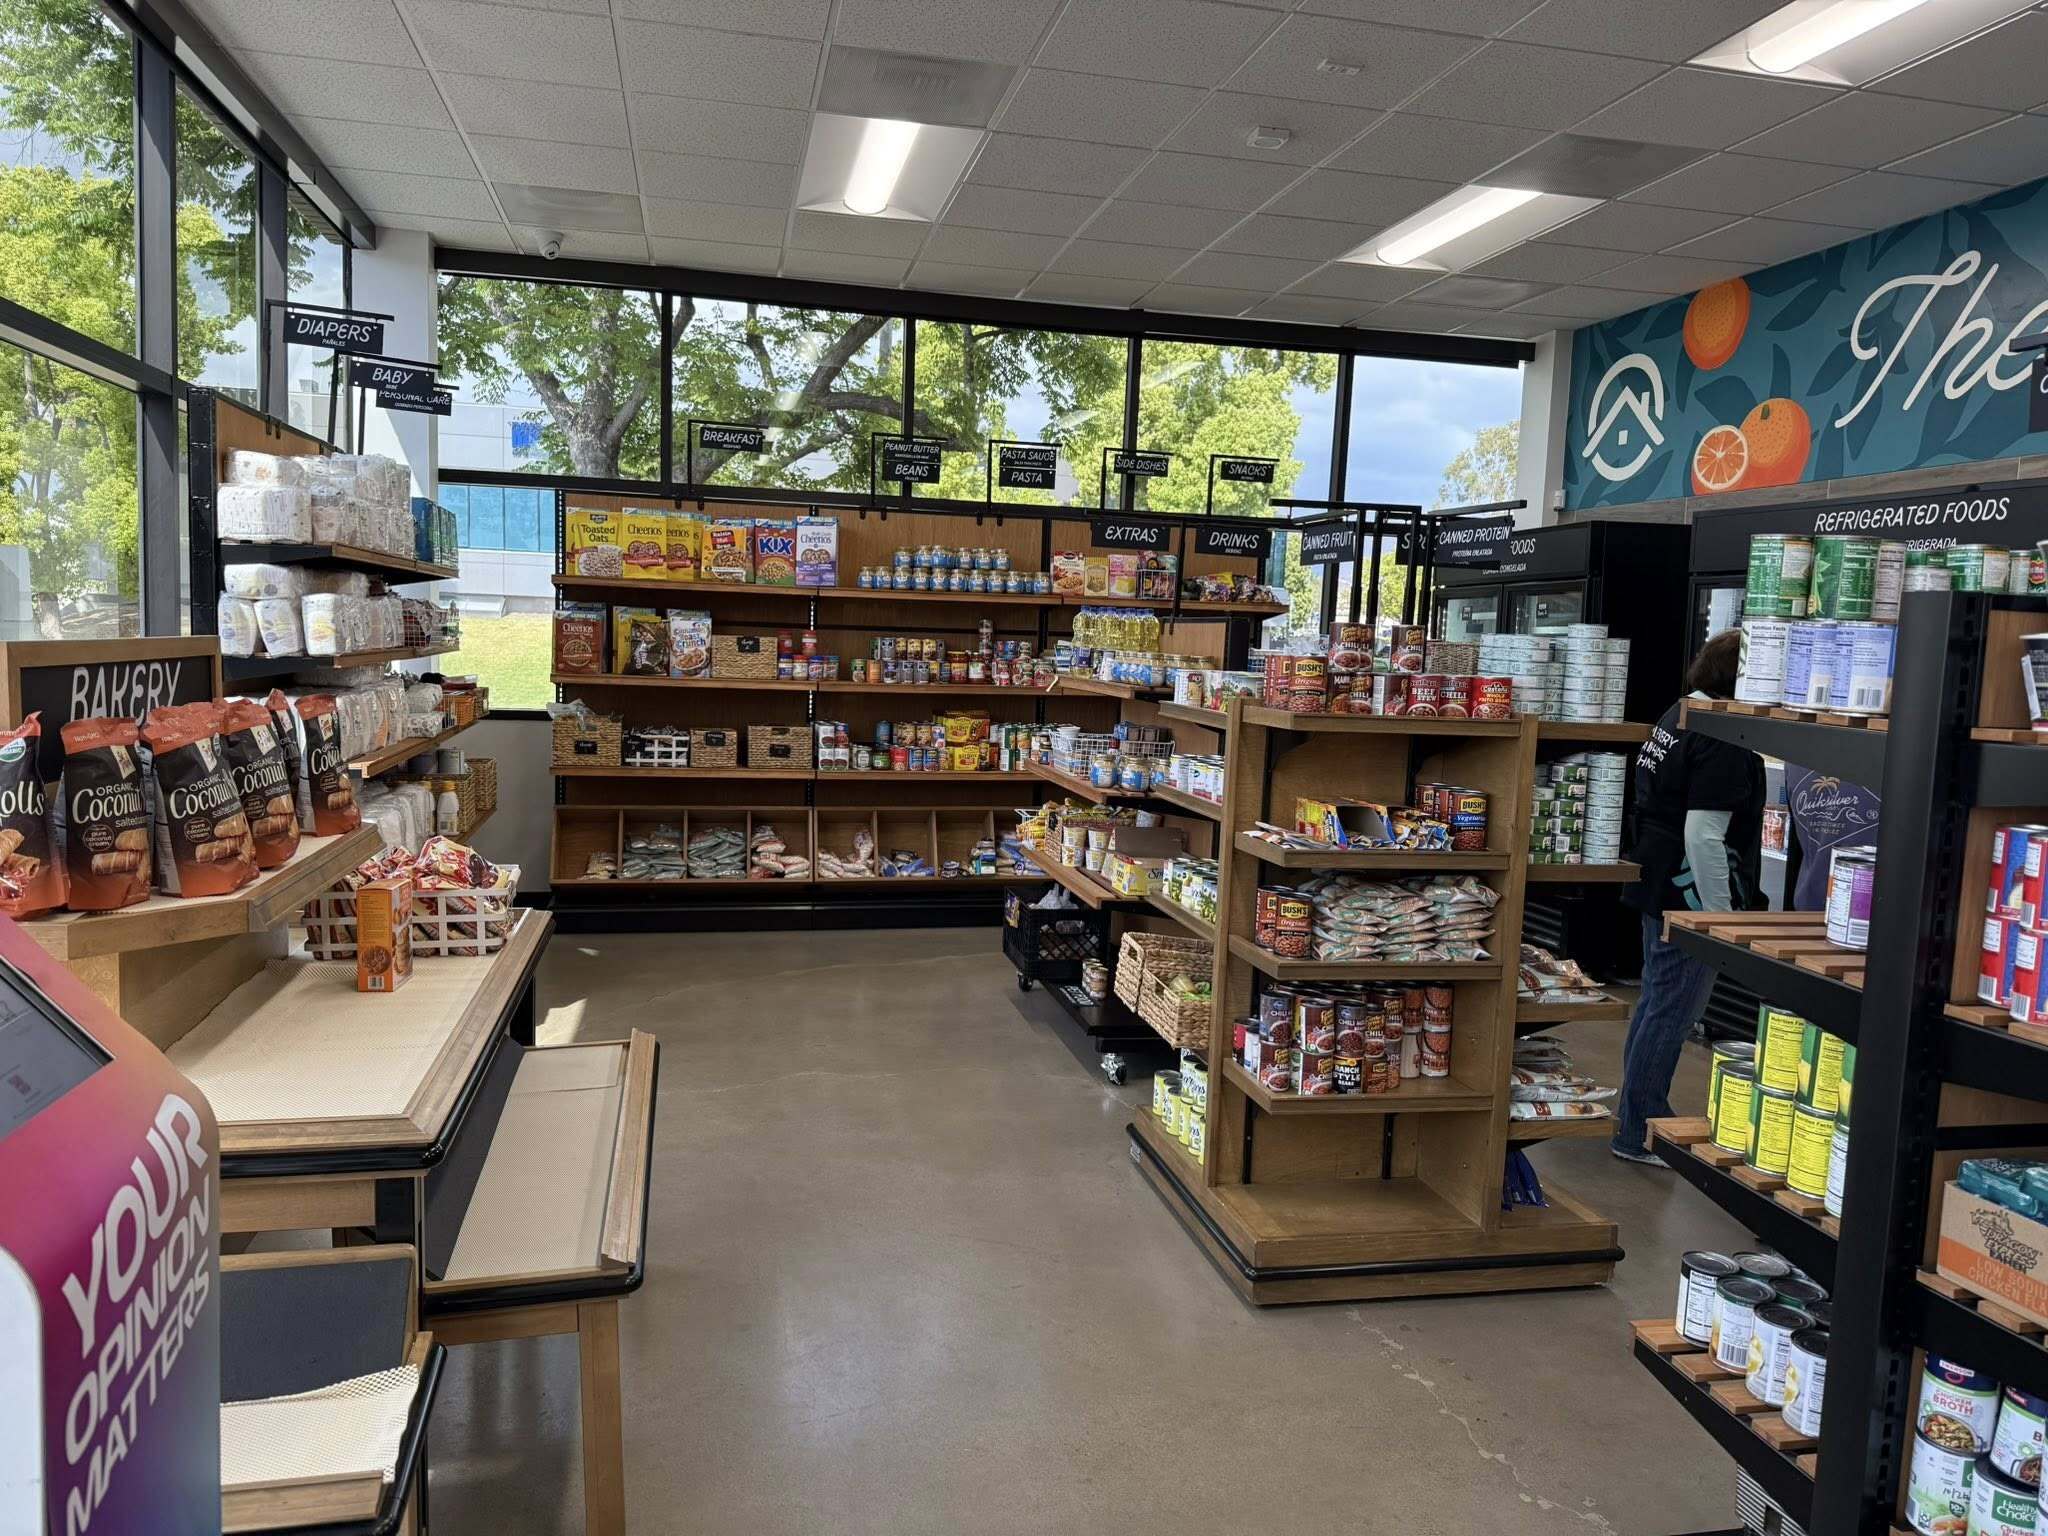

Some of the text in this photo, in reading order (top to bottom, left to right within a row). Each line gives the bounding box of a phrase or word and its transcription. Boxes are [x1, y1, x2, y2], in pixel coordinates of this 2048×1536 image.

[297, 318, 372, 342] DIAPERS
[1834, 250, 2048, 428] The
[372, 367, 413, 384] BABY
[703, 430, 761, 445] BREAKFAST
[885, 442, 939, 454] PEANUT BUTTER
[1001, 450, 1055, 461] PASTA SAUCE
[895, 464, 929, 476] BEANS
[1116, 458, 1167, 471] SIDE DISHES
[1229, 464, 1267, 476] SNACKS
[1011, 471, 1042, 483] PASTA
[1814, 497, 2010, 532] REFRIGERATED FOODS
[581, 524, 616, 534] Toasted
[627, 524, 662, 536] Cheerios
[1105, 526, 1158, 544] EXTRAS
[1440, 529, 1473, 545] CANNED
[1474, 526, 1511, 542] PROTEIN
[589, 534, 608, 542] Oats
[758, 536, 795, 556] KIX
[800, 535, 832, 544] Cheerios
[1209, 531, 1260, 549] DRINKS
[1303, 531, 1354, 551] CANNED FRUIT
[563, 623, 594, 634] Cheerios
[1296, 663, 1324, 672] BUSH'S
[70, 661, 182, 726] BAKERY
[1412, 687, 1436, 695] BEEF
[247, 756, 273, 772] ORGANIC
[189, 774, 221, 792] ORGANIC
[232, 760, 286, 797] Coconut
[95, 783, 135, 797] ORGANIC
[0, 781, 44, 817] olls
[1796, 790, 1858, 812] Quiksilver
[1282, 905, 1308, 915] BUSH'S
[1334, 1073, 1361, 1081] STYLE
[1335, 1065, 1359, 1074] RANCH
[62, 1094, 209, 1358] YOUR
[1976, 1258, 2048, 1299] LOW SODIU
[1968, 1266, 2048, 1318] CHICKEN FLA
[65, 1173, 210, 1466] OPINION
[66, 1247, 210, 1536] MATTERS
[1933, 1393, 1974, 1415] BROTH
[1996, 1506, 2036, 1522] Choice
[2002, 1500, 2039, 1514] Healthy
